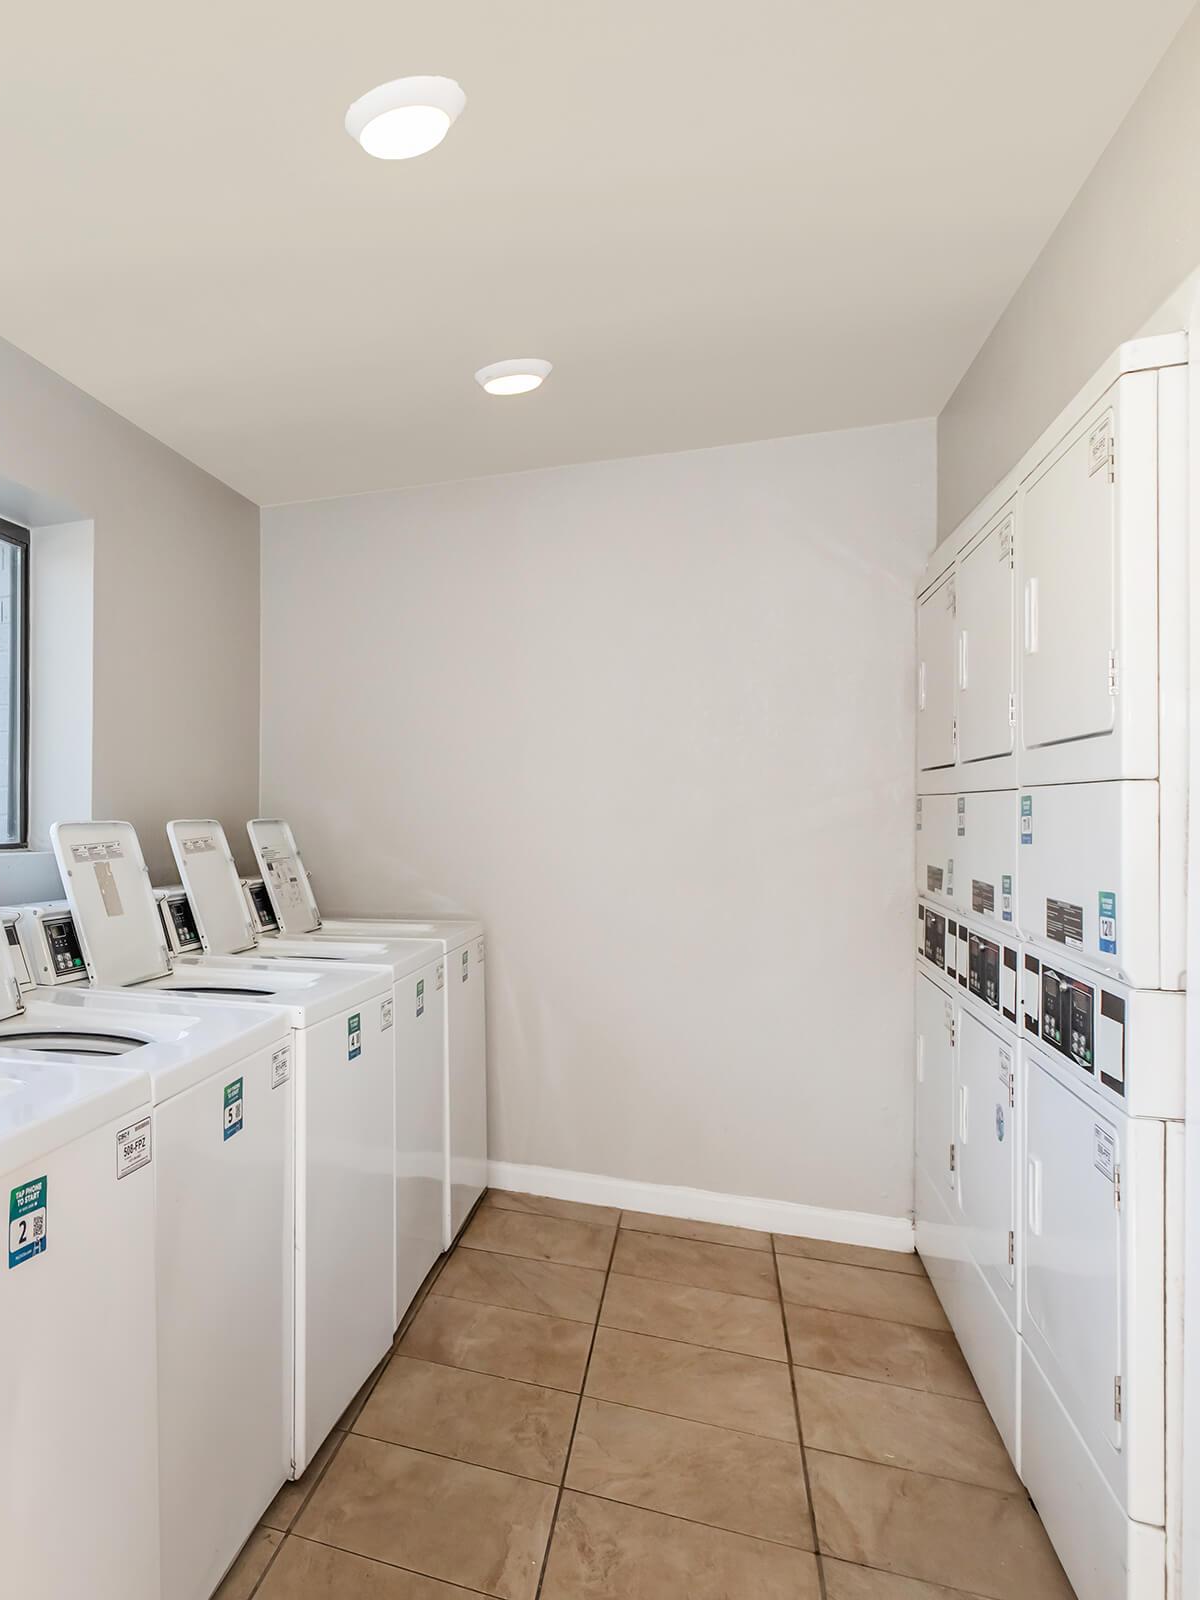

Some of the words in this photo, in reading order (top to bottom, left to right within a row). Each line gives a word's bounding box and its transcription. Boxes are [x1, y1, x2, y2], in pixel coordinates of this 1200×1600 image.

[228, 1107, 233, 1124] 5
[16, 1190, 26, 1200] TAP
[17, 1198, 24, 1206] TO
[24, 1191, 40, 1204] START
[18, 1220, 27, 1244] 2
